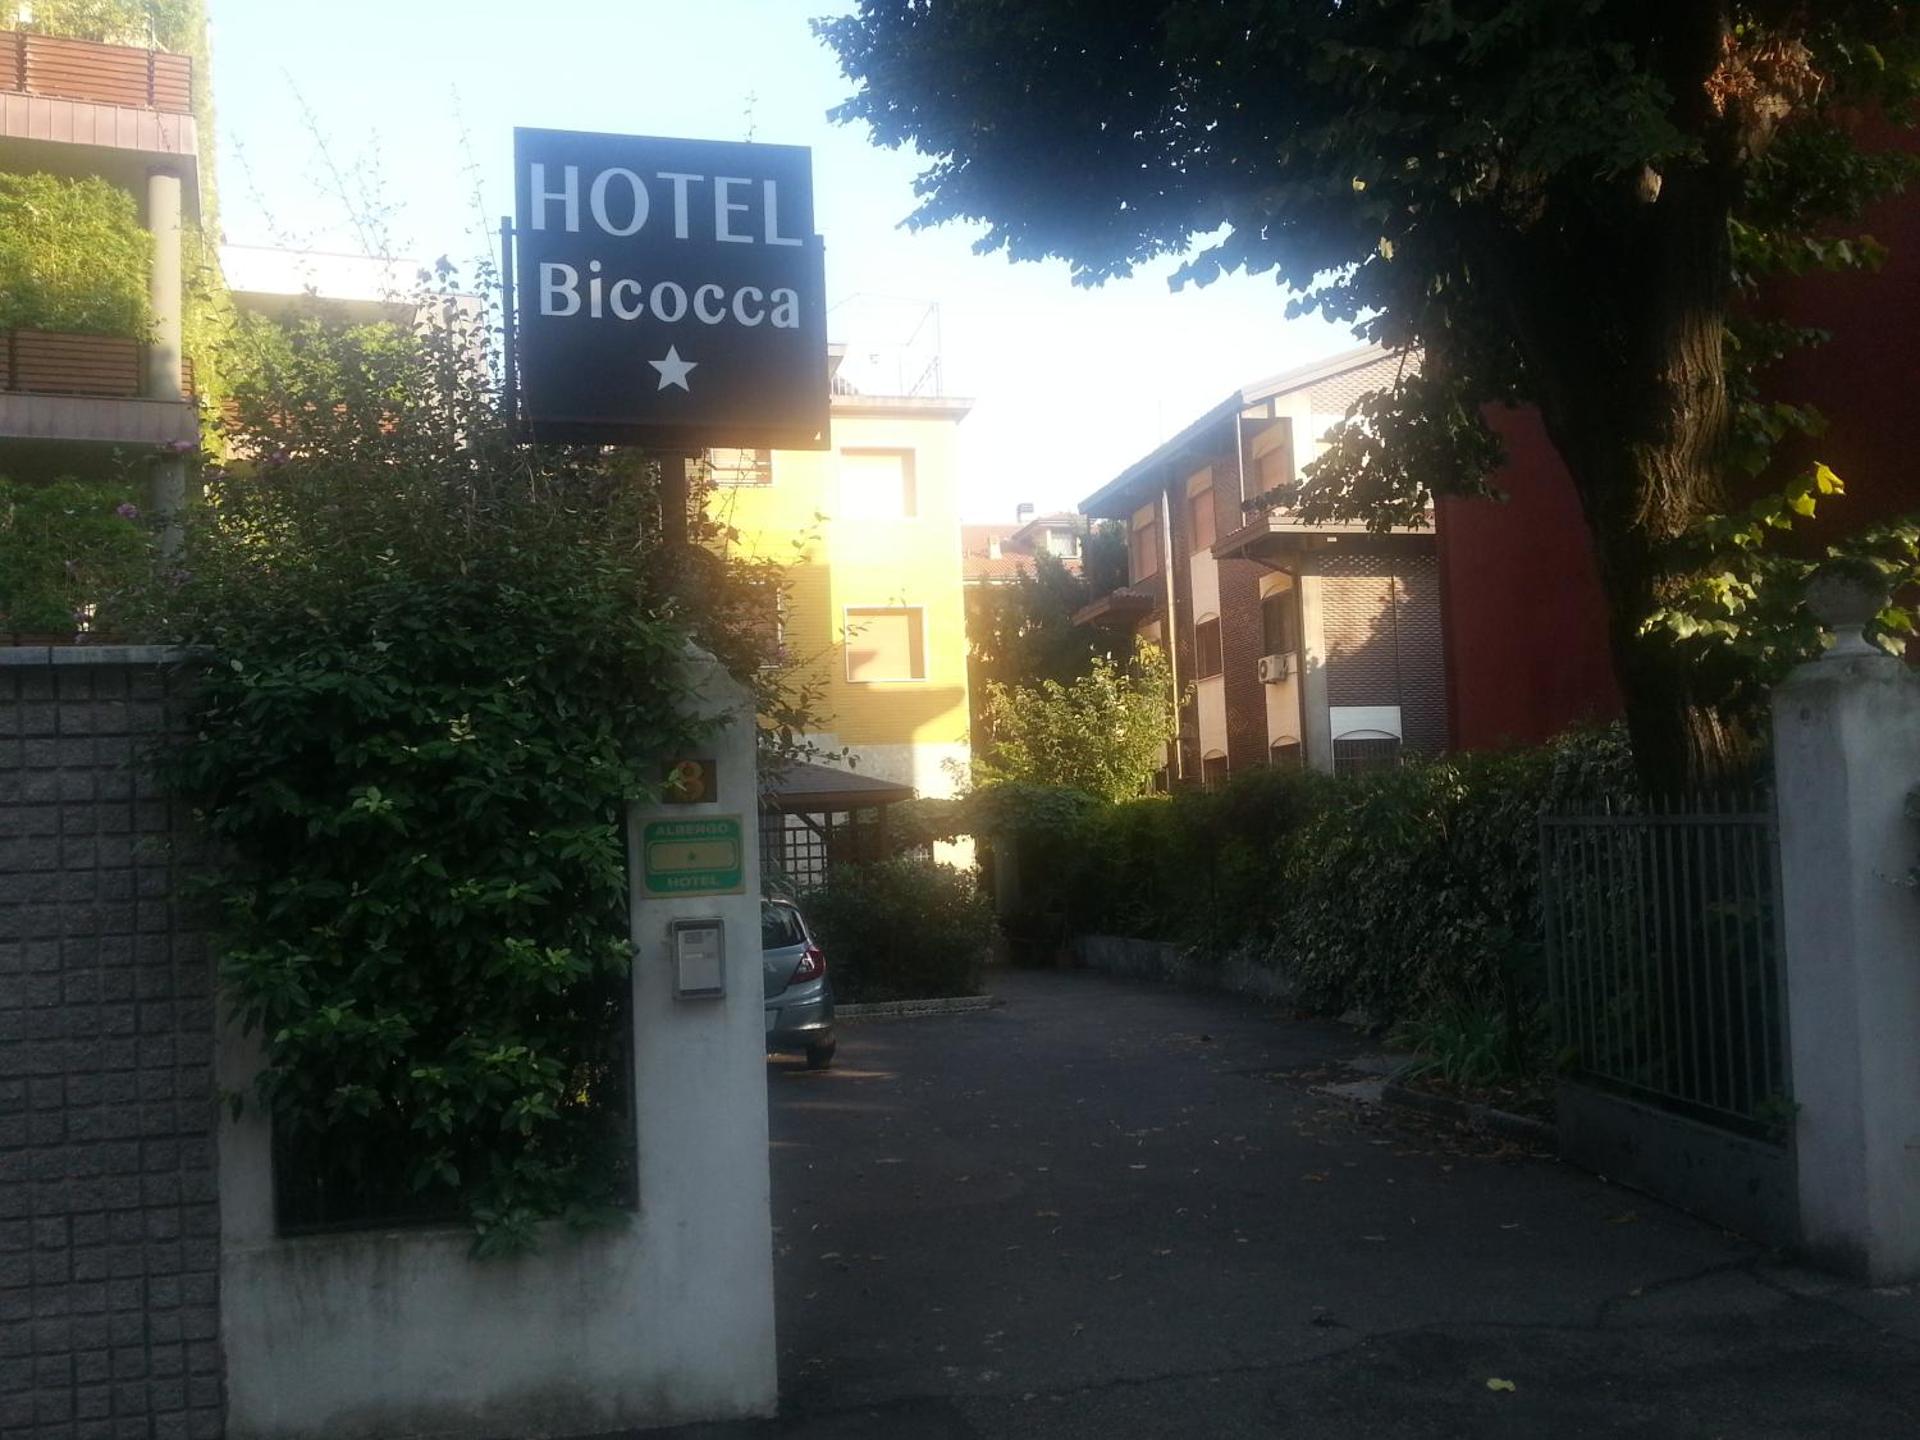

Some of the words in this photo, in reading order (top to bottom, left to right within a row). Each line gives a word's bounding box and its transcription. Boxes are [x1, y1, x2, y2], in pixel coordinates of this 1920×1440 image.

[531, 163, 803, 246] HOTEL
[540, 260, 799, 328] Bicocca
[656, 822, 728, 836] ALBERGO
[667, 875, 721, 887] HOTEL
